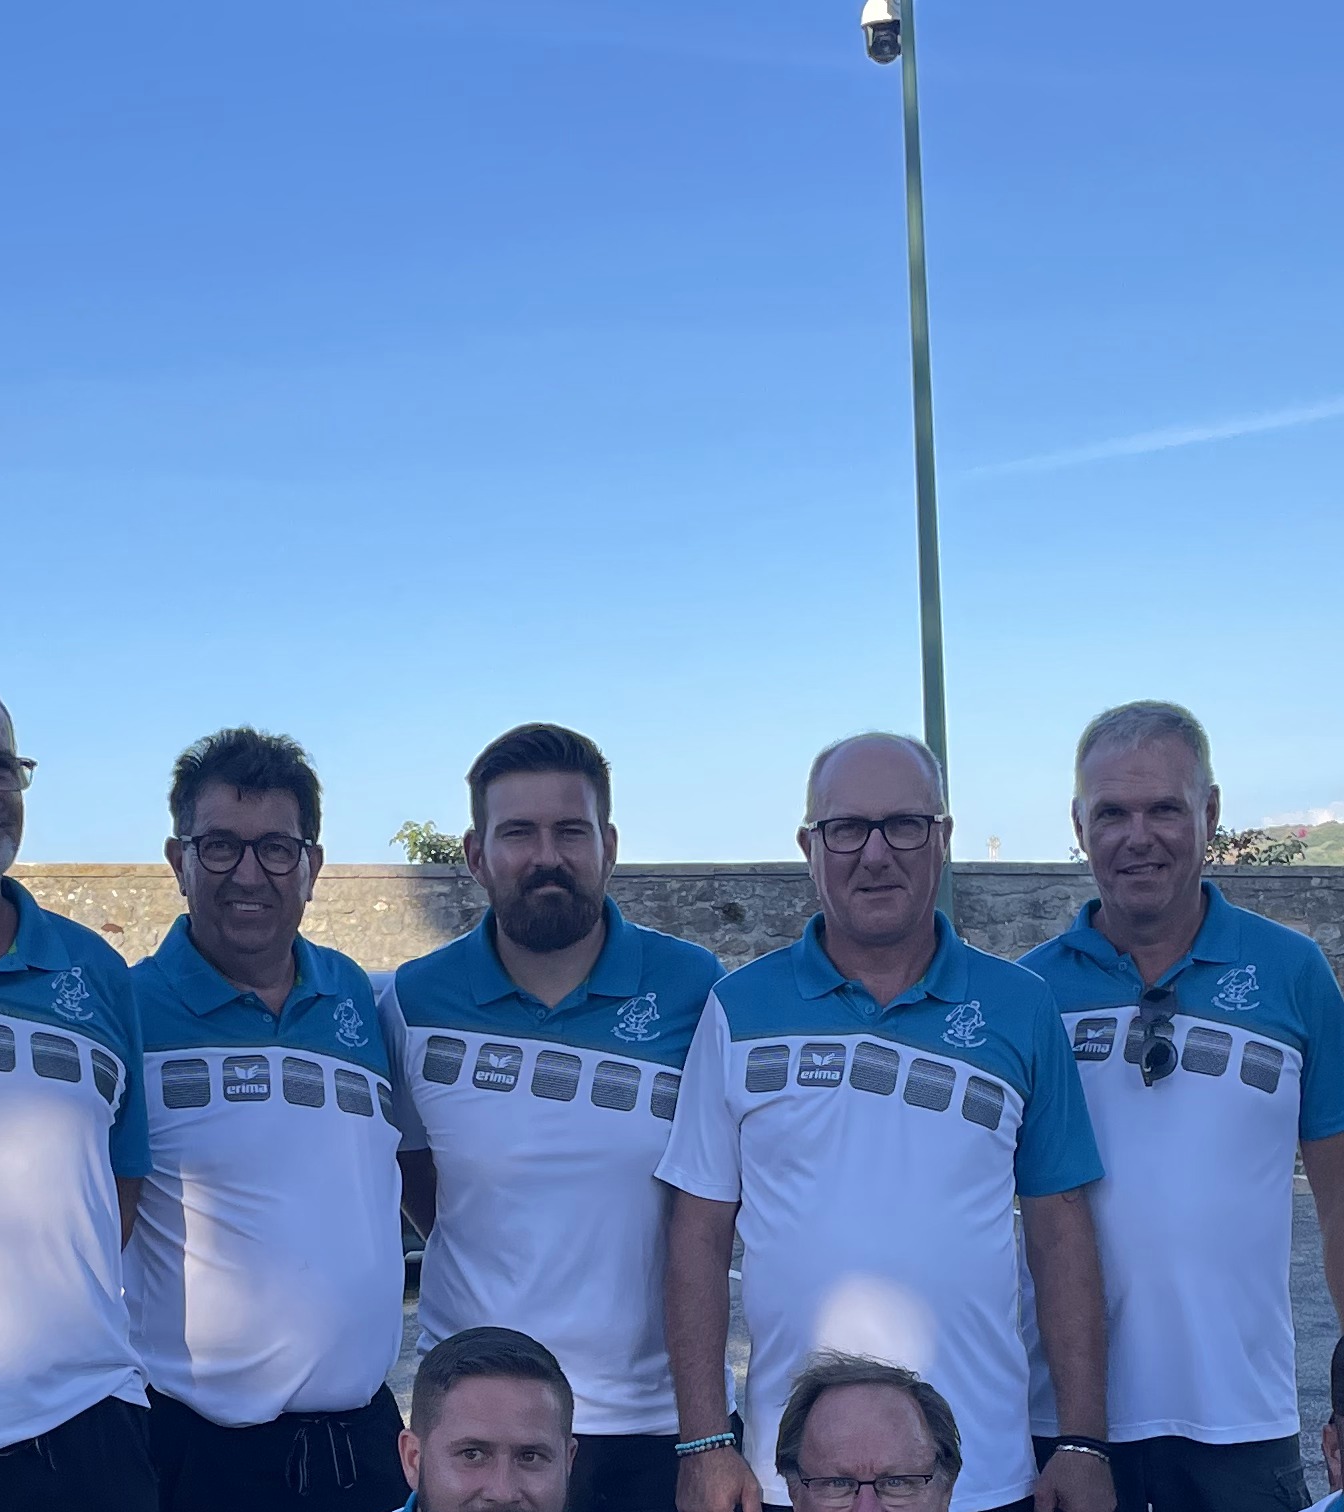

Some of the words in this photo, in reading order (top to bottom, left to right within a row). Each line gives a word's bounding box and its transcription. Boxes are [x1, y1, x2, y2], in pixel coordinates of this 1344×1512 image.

[475, 1070, 516, 1085] erima
[800, 1068, 841, 1081] erima
[226, 1083, 268, 1095] erima
